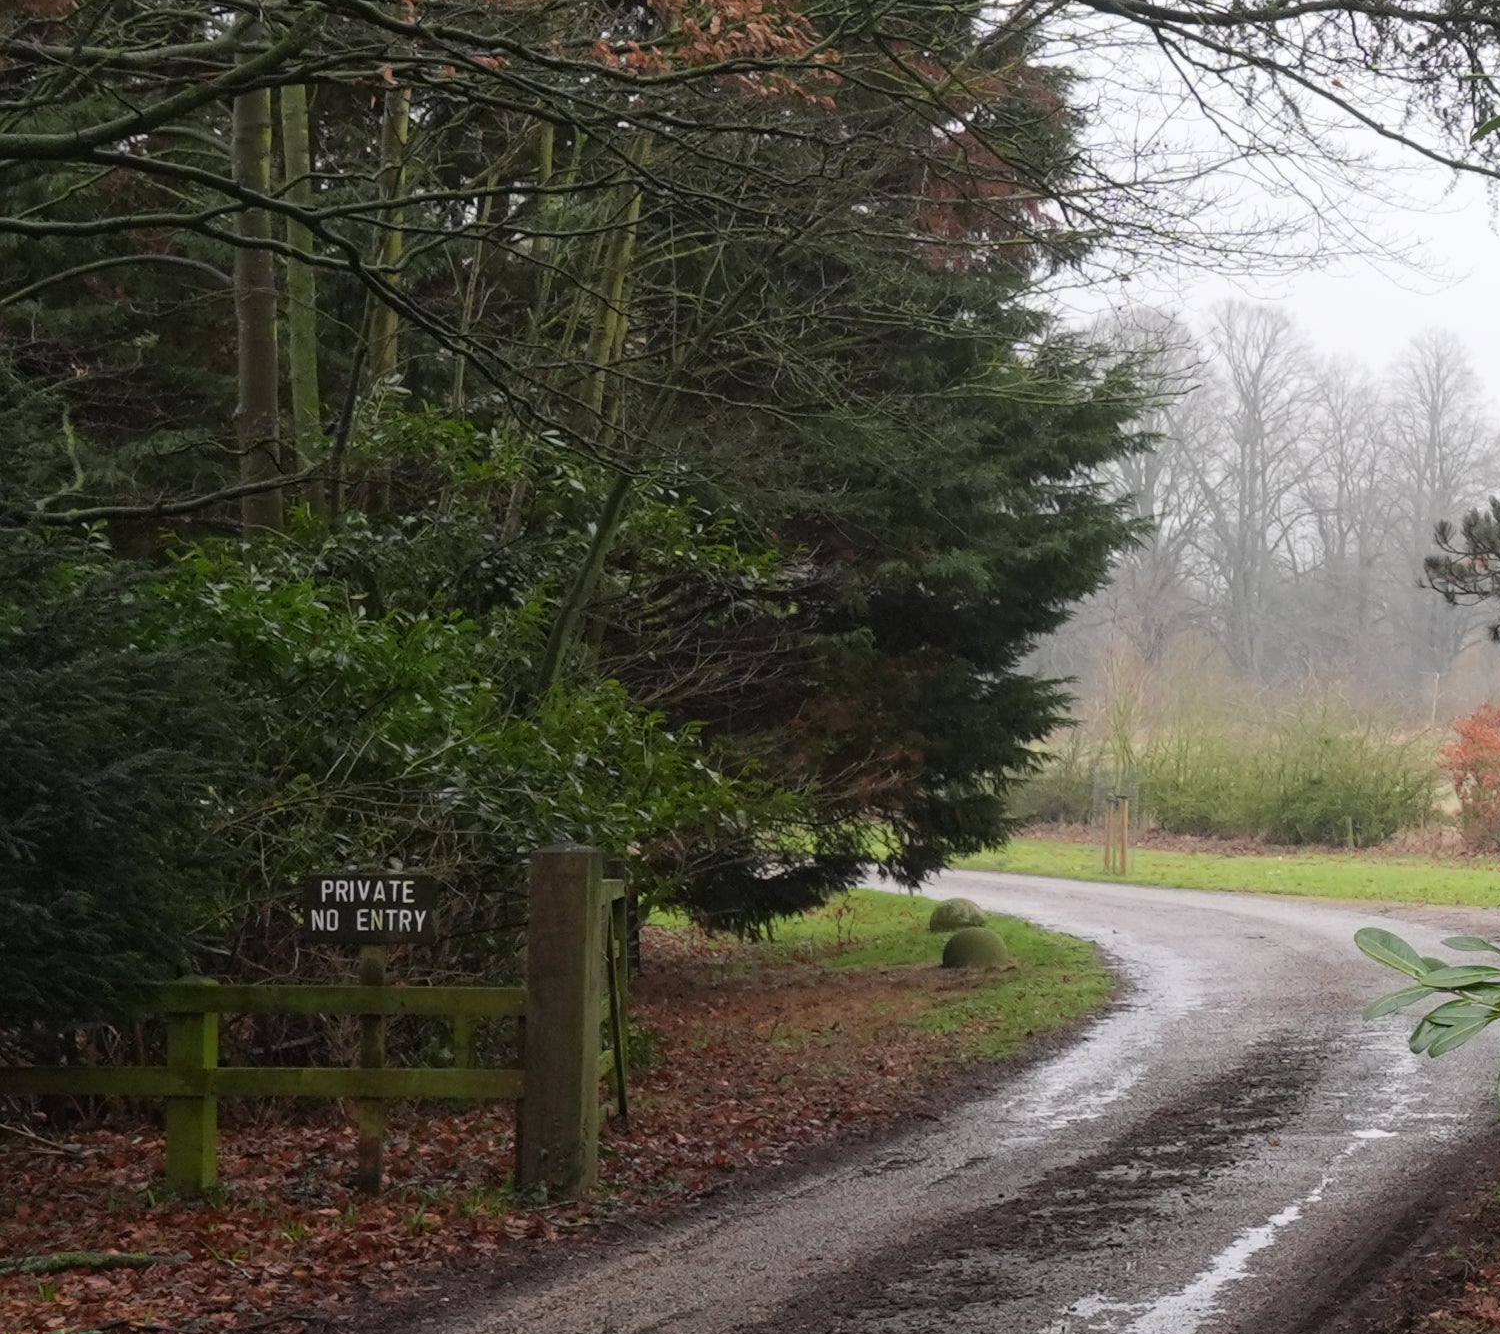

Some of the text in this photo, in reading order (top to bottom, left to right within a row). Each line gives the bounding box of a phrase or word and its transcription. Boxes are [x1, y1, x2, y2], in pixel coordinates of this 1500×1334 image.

[321, 879, 415, 903] PRIVATE
[311, 908, 427, 932] NO ENTRY
